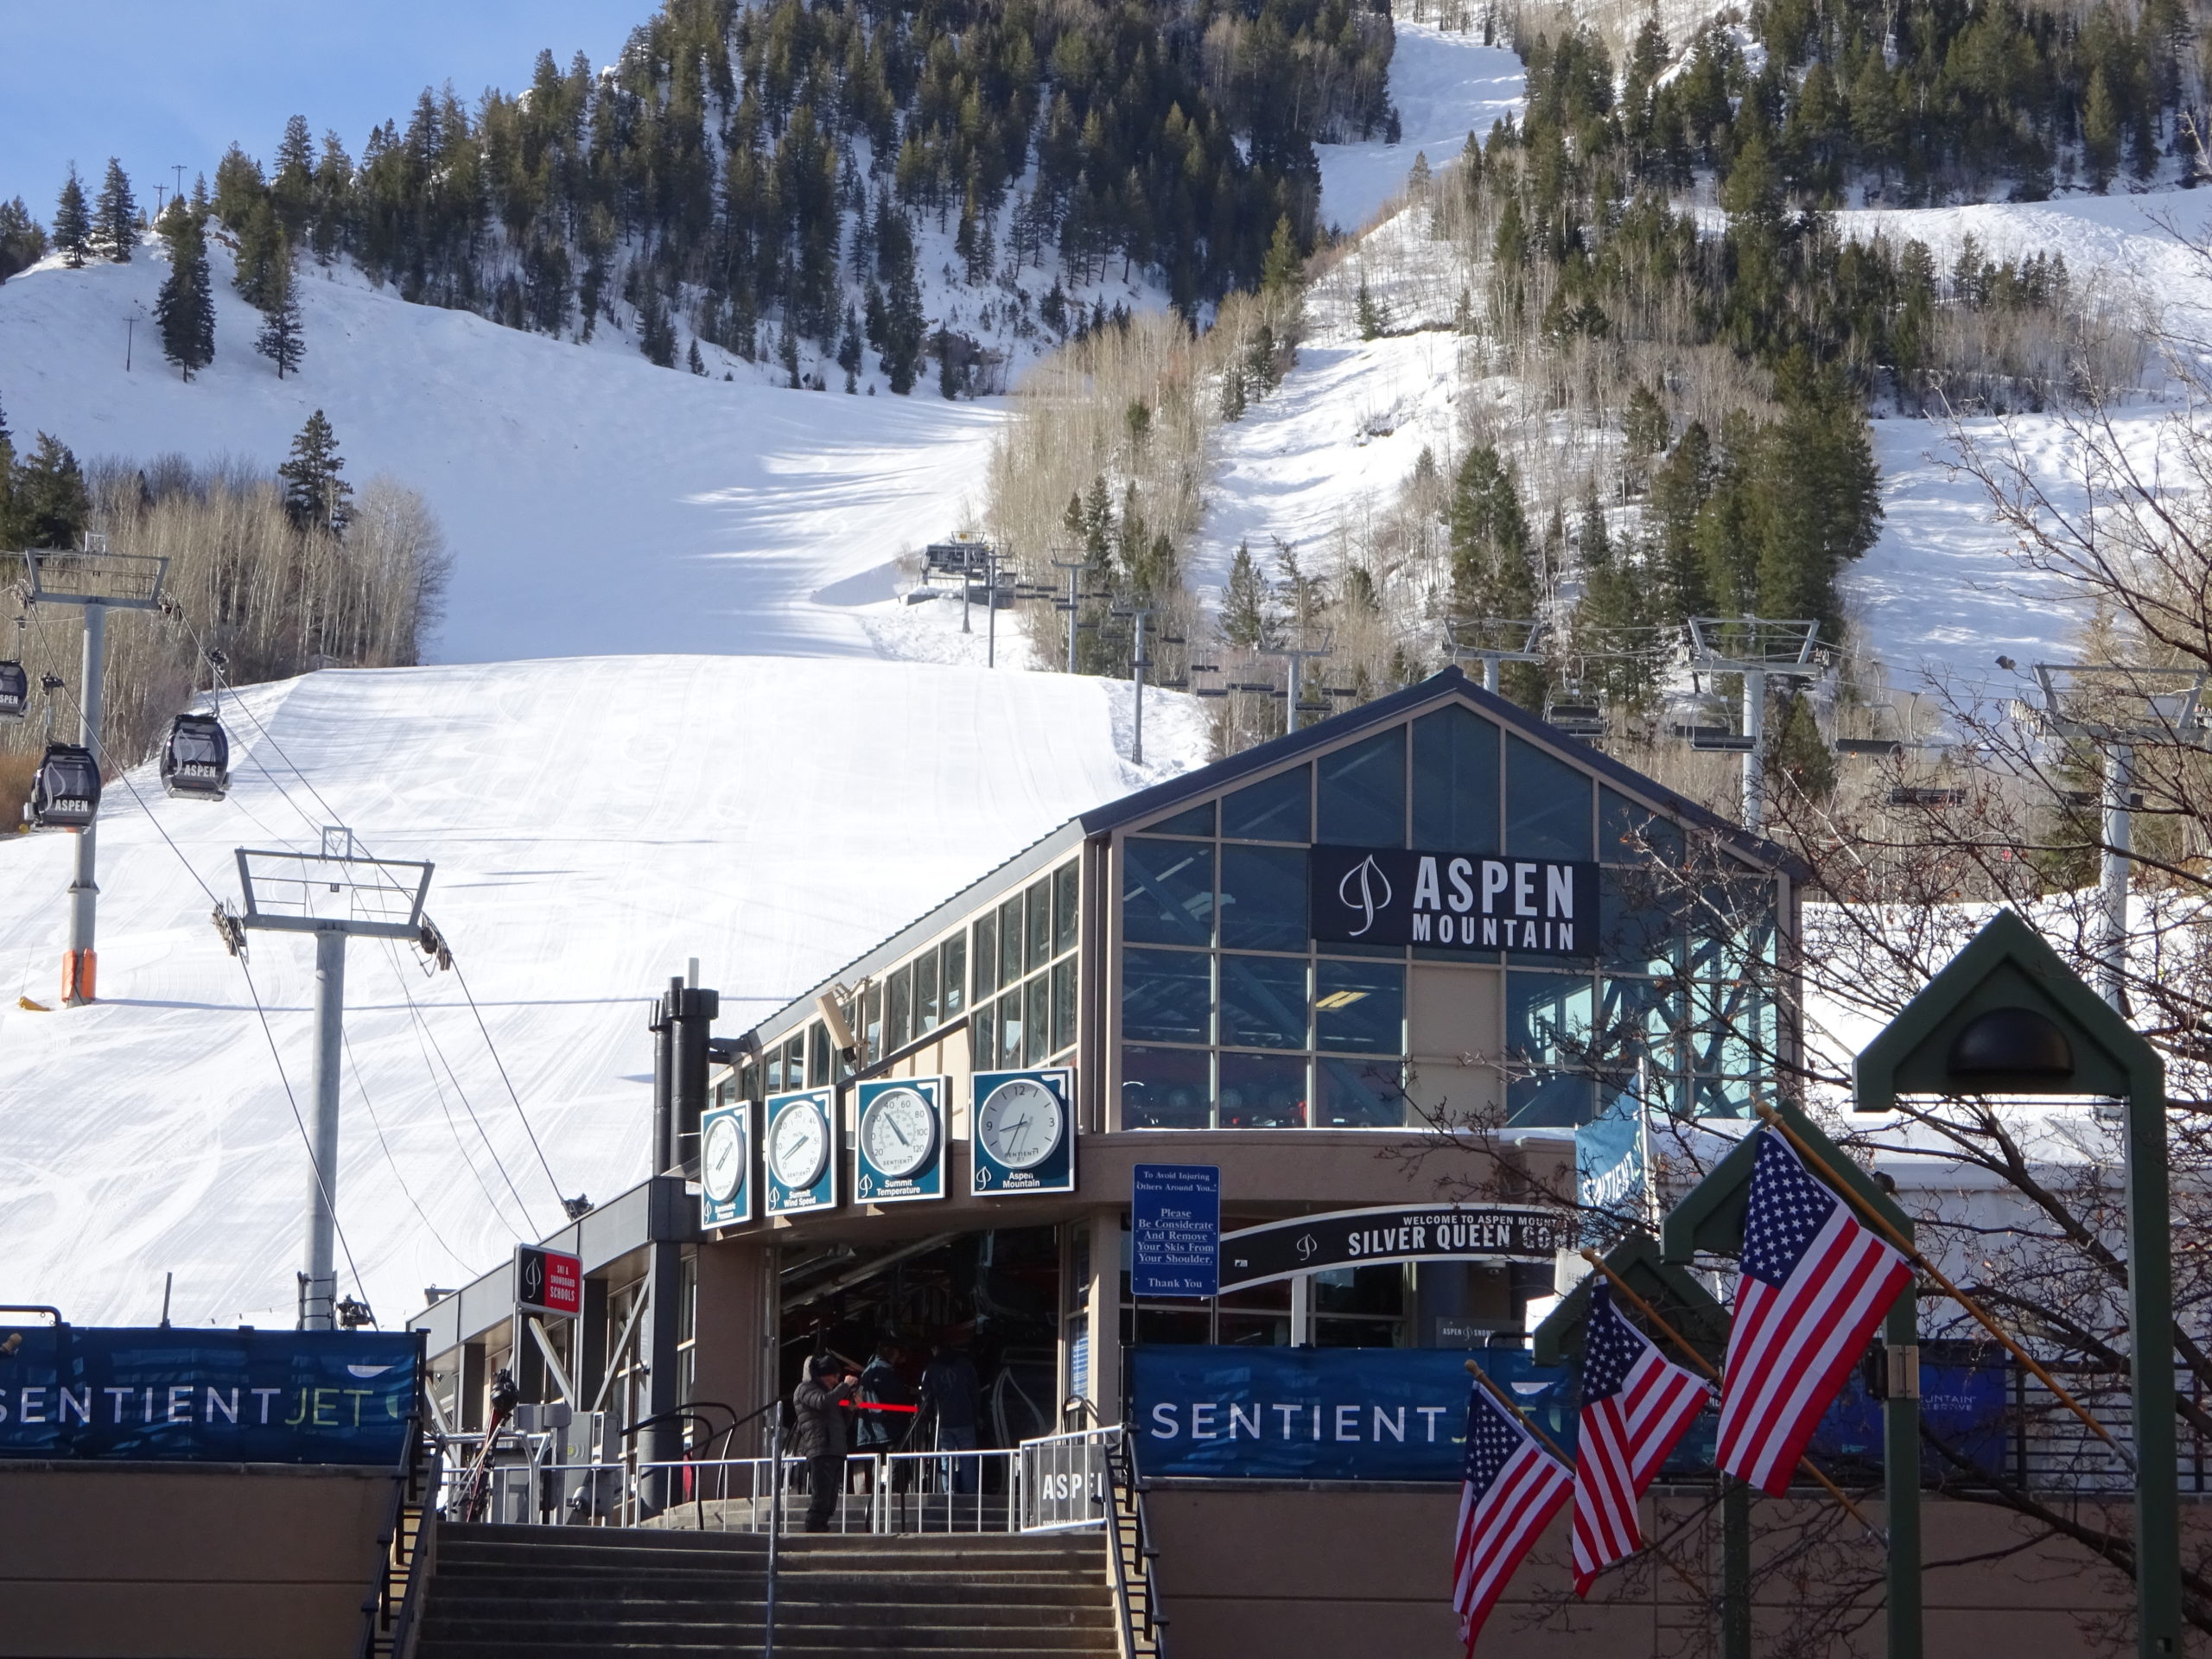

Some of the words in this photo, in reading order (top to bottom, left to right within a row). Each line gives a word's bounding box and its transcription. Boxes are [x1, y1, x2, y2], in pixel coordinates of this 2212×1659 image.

[184, 765, 216, 777] ASPEN
[55, 799, 88, 811] ASPEN
[1413, 855, 1573, 918] ASPEN
[1412, 913, 1573, 950] MOUNTAIN
[1014, 1086, 1025, 1096] 12
[900, 1100, 911, 1109] 60
[794, 1111, 802, 1120] 30
[987, 1122, 993, 1131] 9
[1049, 1117, 1055, 1127] 3
[1009, 1172, 1033, 1180] Aspen
[1143, 1171, 1154, 1179] To
[1156, 1171, 1176, 1179] Avoid
[1179, 1173, 1210, 1182] Injuring
[885, 1179, 912, 1188] Summit
[1002, 1179, 1040, 1189] Mountain
[789, 1190, 811, 1198] Summit
[876, 1186, 921, 1197] Temperature
[784, 1198, 798, 1208] Wind
[798, 1196, 817, 1206] Speed
[1160, 1208, 1192, 1218] Please
[1139, 1219, 1151, 1228] Be
[1155, 1219, 1214, 1230] Considerate
[1403, 1215, 1458, 1226] WELCOME
[1461, 1215, 1473, 1224] TO
[1478, 1215, 1513, 1225] ASPEN
[1144, 1230, 1165, 1240] And
[1169, 1231, 1208, 1241] Remove
[1348, 1224, 1426, 1255] SILVER
[1437, 1224, 1510, 1250] QUEEN
[1137, 1242, 1160, 1251] Your
[1165, 1243, 1185, 1252] Skis
[1188, 1243, 1214, 1253] From
[1138, 1253, 1162, 1262] Your
[1148, 1278, 1180, 1287] Thank
[1184, 1279, 1202, 1288] You
[550, 1286, 575, 1302] SCHOOLS
[1442, 1327, 1462, 1336] ASPEN
[1918, 1394, 1973, 1404] OUNTAIN
[0, 1386, 281, 1424] ENTIENT
[284, 1387, 373, 1427] JET
[1150, 1402, 1447, 1443] SENTIENT
